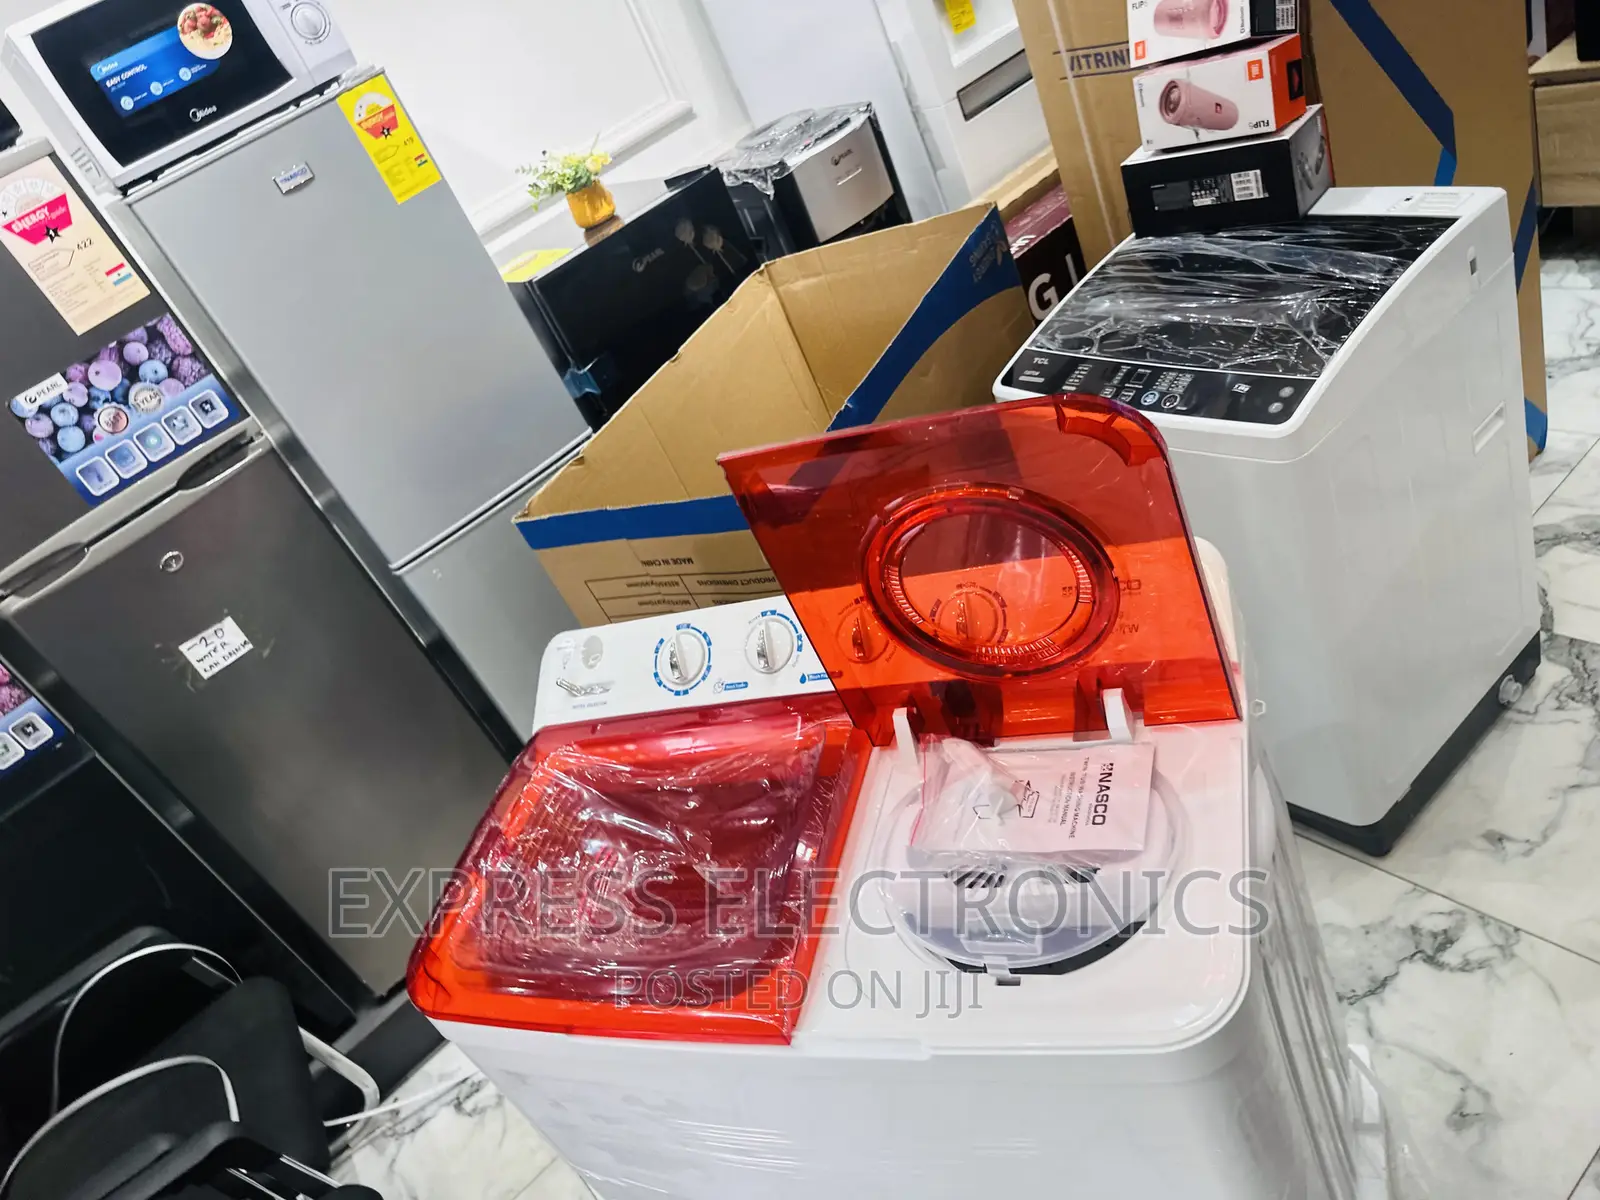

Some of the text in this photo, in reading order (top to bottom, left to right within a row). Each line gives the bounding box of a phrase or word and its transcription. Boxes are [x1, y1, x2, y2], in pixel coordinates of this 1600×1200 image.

[11, 205, 51, 232] ENERGY
[1033, 357, 1049, 365] TCL
[37, 380, 63, 398] PEARL
[662, 558, 672, 566] IN
[674, 557, 694, 566] MADE
[1091, 771, 1114, 826] NASCO
[1068, 811, 1081, 840] MACHINE
